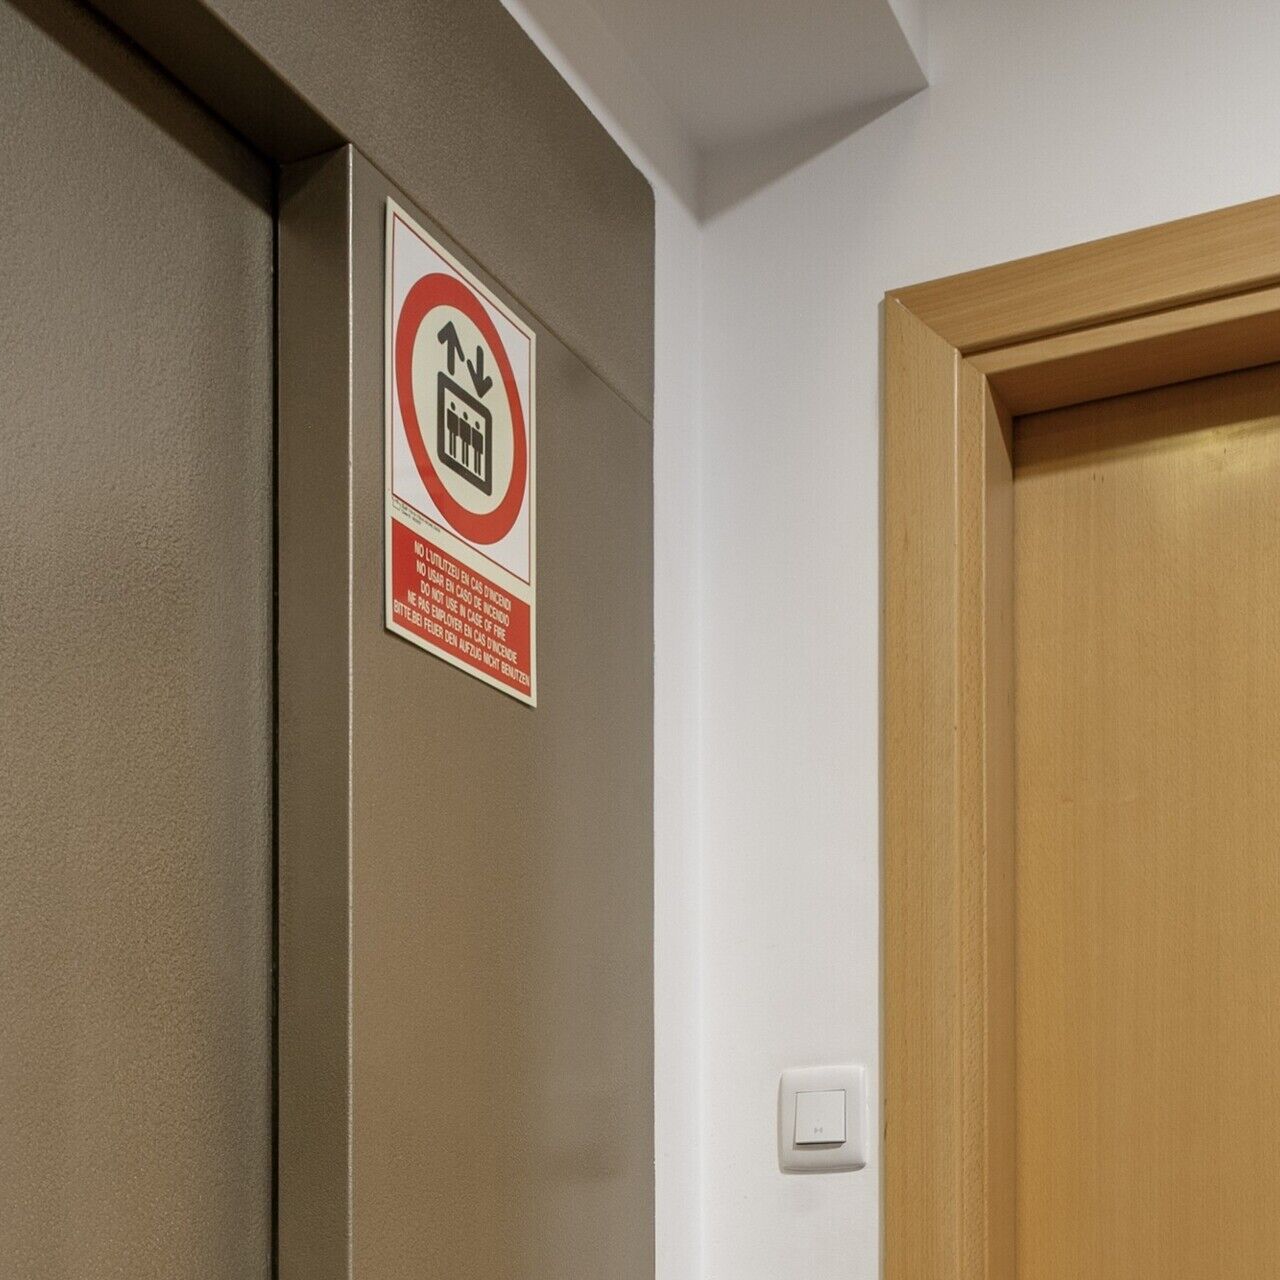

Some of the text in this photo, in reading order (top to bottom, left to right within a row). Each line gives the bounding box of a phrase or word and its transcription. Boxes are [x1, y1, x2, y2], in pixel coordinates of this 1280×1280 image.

[414, 540, 424, 558] NO
[461, 570, 470, 586] EN
[471, 577, 483, 595] CAS
[416, 559, 510, 627] NO USAR EN CASO DE INCENDIO
[407, 589, 518, 664] NE PAS EMPLOYER EN CAS D'INCENDIE
[421, 580, 506, 642] DO NOT USE IN CASE OF FIRE
[424, 617, 444, 640] FEUER
[444, 629, 458, 647] DEN
[459, 638, 482, 661] AUFZUG
[483, 651, 500, 671] NICHT
[501, 661, 530, 688] BENUTZEN
